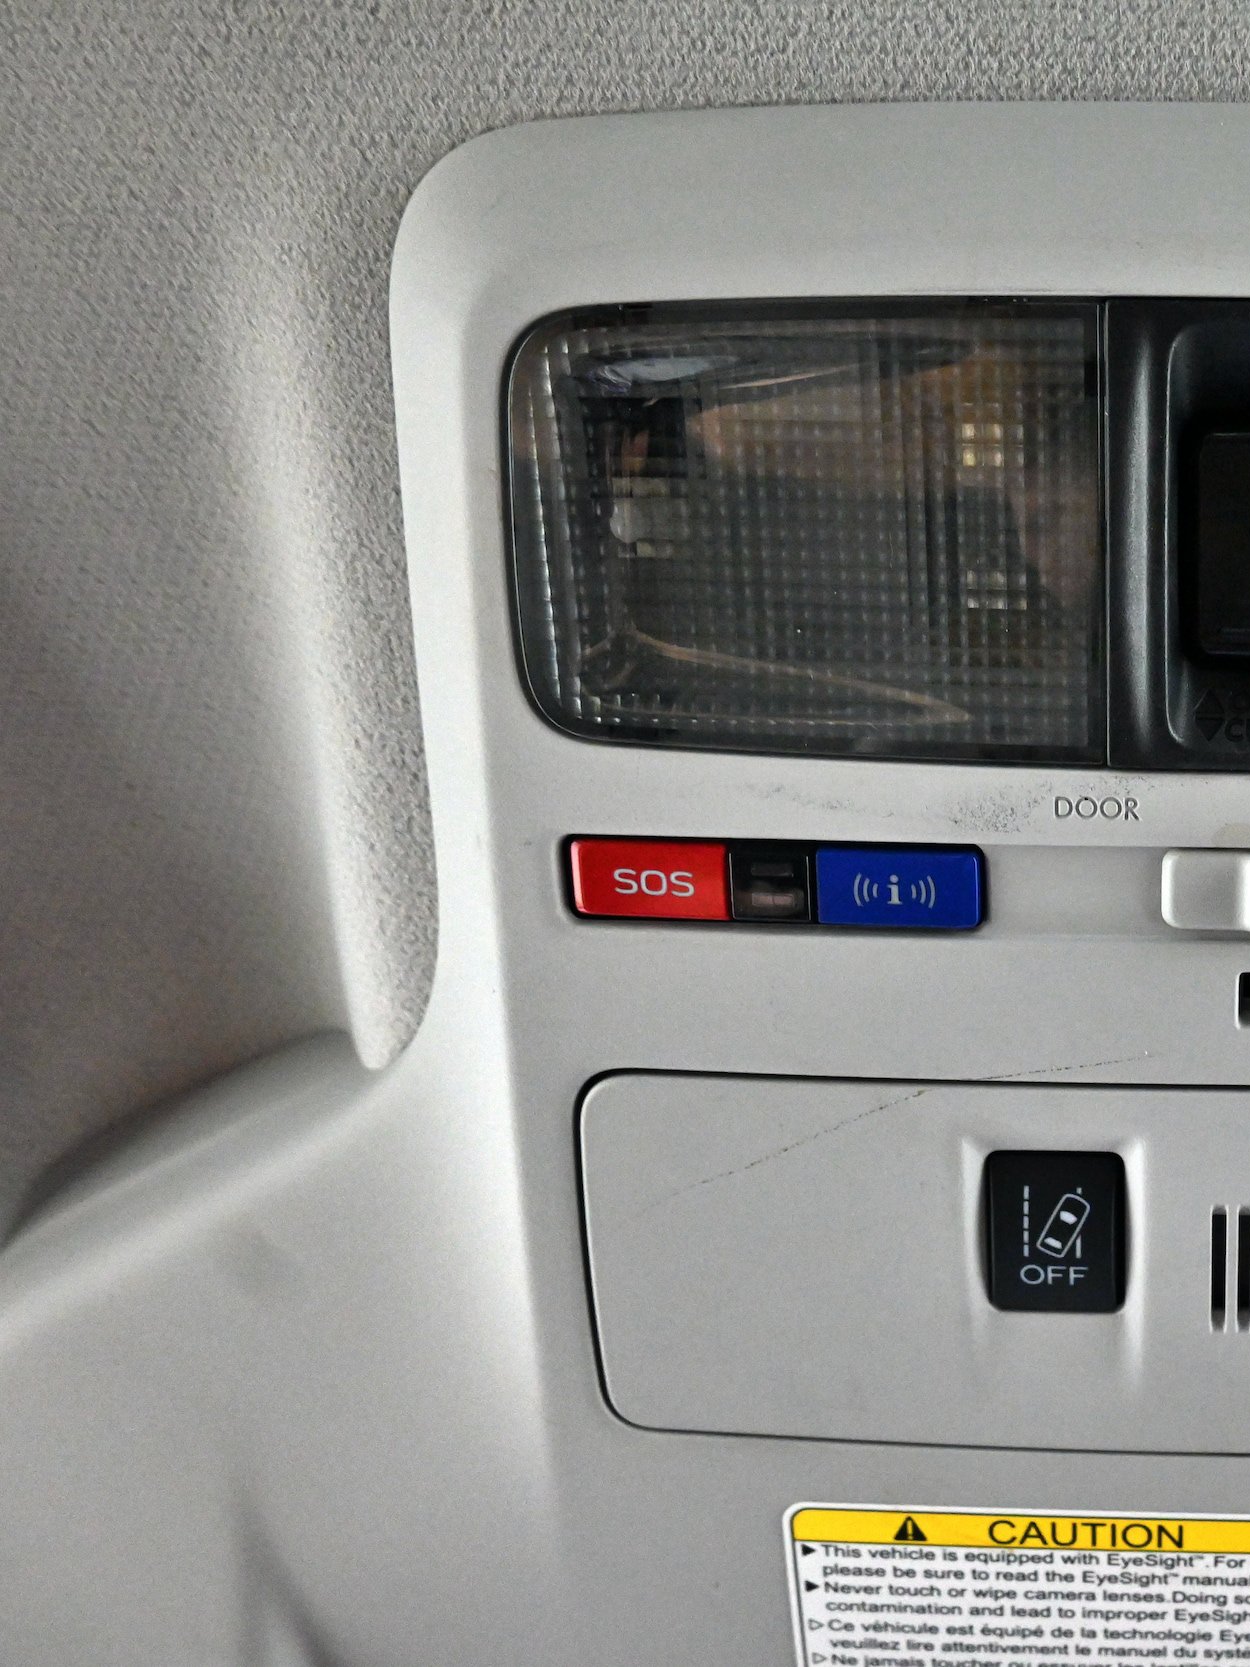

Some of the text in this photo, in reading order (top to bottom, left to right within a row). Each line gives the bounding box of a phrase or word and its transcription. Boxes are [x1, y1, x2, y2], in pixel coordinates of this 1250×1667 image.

[1054, 796, 1140, 821] DOOR
[613, 868, 695, 897] SOS
[1019, 1264, 1089, 1286] OFF
[987, 1519, 1184, 1549] CAUTION
[821, 1544, 862, 1558] This
[868, 1548, 936, 1561] vehicle
[942, 1549, 958, 1562] is
[965, 1551, 1054, 1565] equipped
[1062, 1553, 1100, 1565] with
[1214, 1556, 1245, 1569] For
[823, 1564, 886, 1577] please
[893, 1566, 917, 1578] be
[923, 1568, 965, 1580] sure
[971, 1569, 990, 1581] to
[995, 1570, 1039, 1582] read
[1045, 1571, 1075, 1583] the
[824, 1581, 882, 1595] Never
[888, 1584, 941, 1596] touch
[947, 1587, 966, 1597] or
[974, 1589, 1016, 1601] wipe
[1024, 1590, 1096, 1601] camera
[826, 1601, 962, 1615] contamination
[969, 1604, 1004, 1616] and
[1011, 1606, 1051, 1618] lead
[1058, 1607, 1075, 1618] to
[1082, 1608, 1168, 1622] improper
[828, 1619, 855, 1632] Ce
[946, 1624, 974, 1636] est
[980, 1624, 1044, 1639] équipé
[1051, 1628, 1074, 1639] de
[1081, 1628, 1096, 1639] la
[1104, 1628, 1212, 1643] technologie
[906, 1640, 935, 1651] lire
[941, 1643, 1069, 1656] attentivement
[1076, 1644, 1091, 1656] le
[1098, 1645, 1168, 1658] manuel
[1174, 1646, 1196, 1658] du
[831, 1654, 859, 1667] Ne
